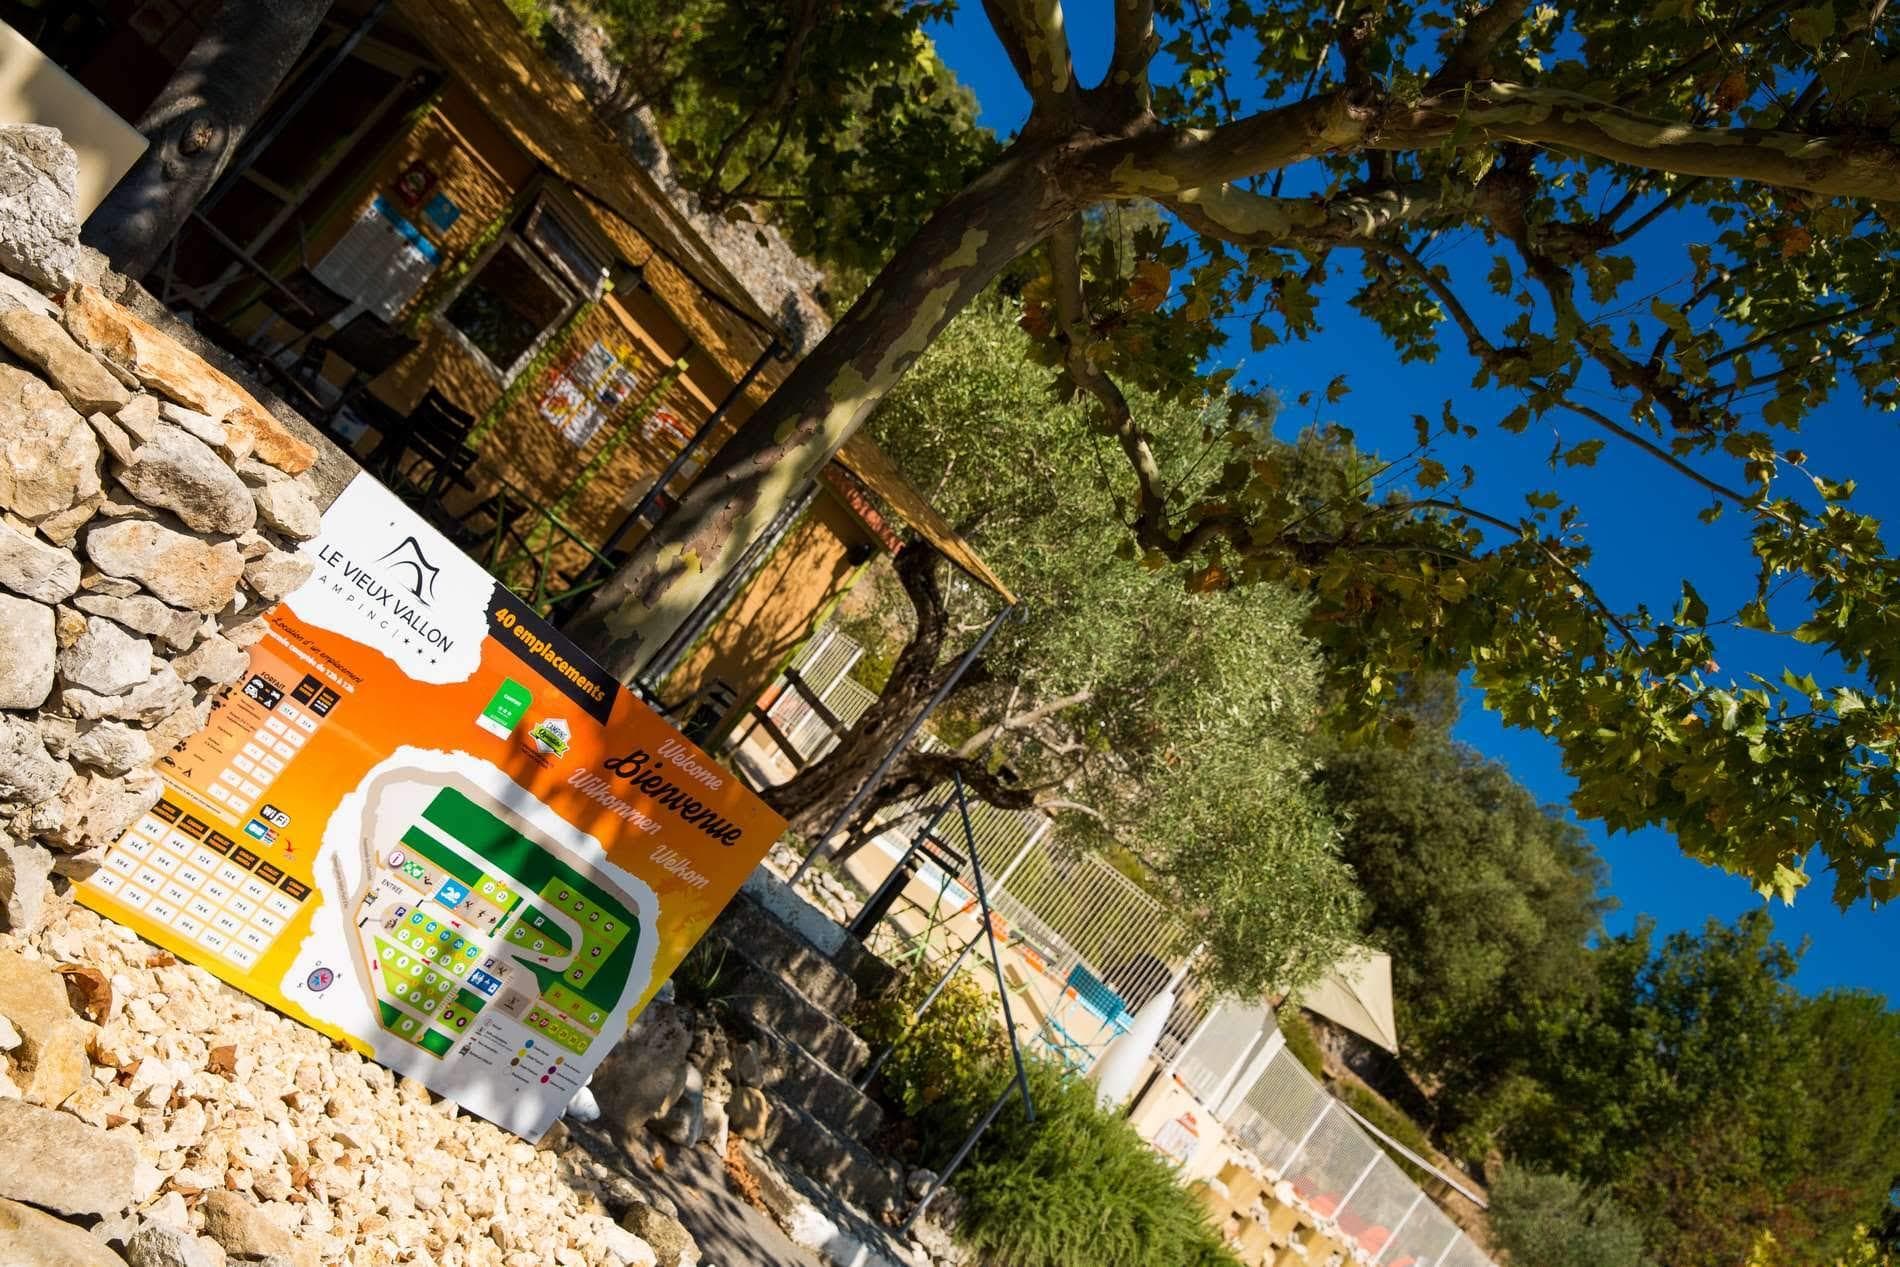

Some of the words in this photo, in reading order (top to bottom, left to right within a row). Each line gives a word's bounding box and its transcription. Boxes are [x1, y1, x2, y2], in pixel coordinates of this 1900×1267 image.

[317, 544, 343, 568] LE
[340, 561, 394, 607] VIEUX
[389, 599, 454, 653] VALLON
[260, 670, 286, 690] FORFAIT
[271, 618, 304, 641] Location
[319, 652, 364, 683] emplacement
[492, 605, 517, 630] 40
[511, 622, 606, 702] emplacements
[658, 737, 723, 791] Welcome
[603, 754, 741, 846] Bienvenue
[380, 877, 404, 895] ENTRÉE
[649, 846, 710, 889] Welkom
